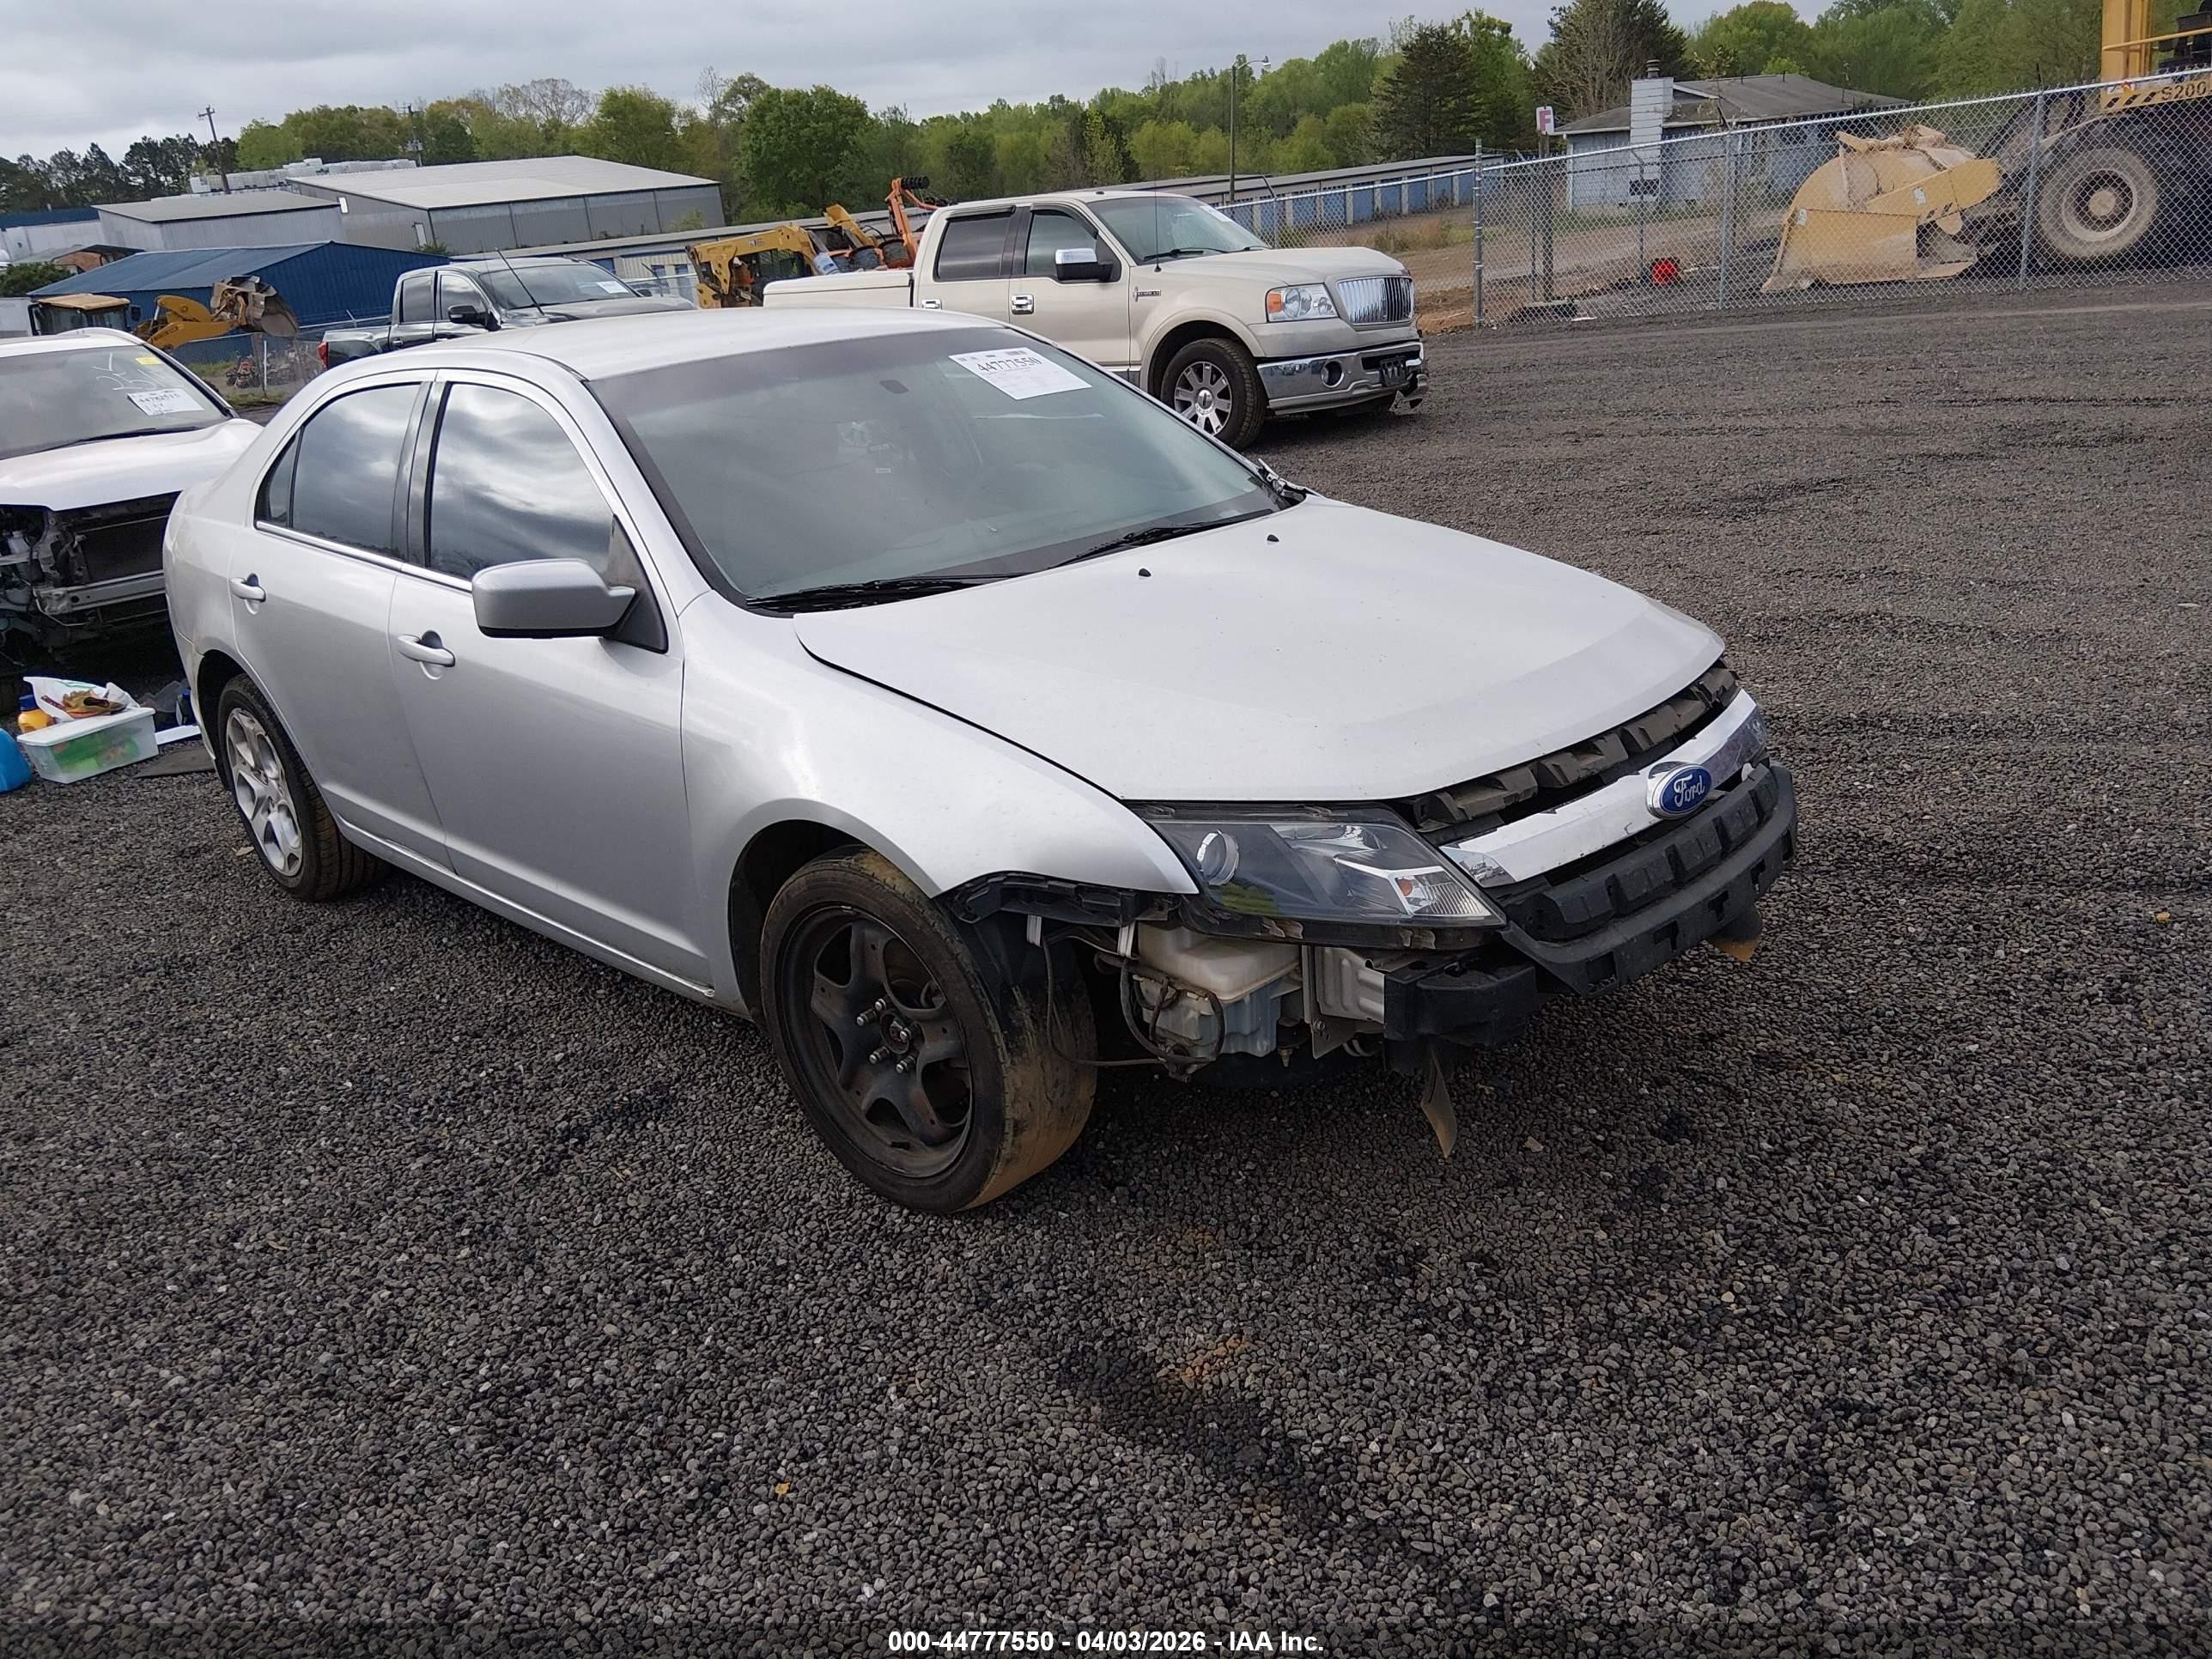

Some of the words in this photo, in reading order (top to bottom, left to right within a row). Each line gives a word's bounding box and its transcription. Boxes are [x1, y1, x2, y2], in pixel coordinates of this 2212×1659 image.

[1538, 109, 1552, 131] F
[976, 356, 1042, 372] 44777550
[1673, 773, 1705, 808] Ford
